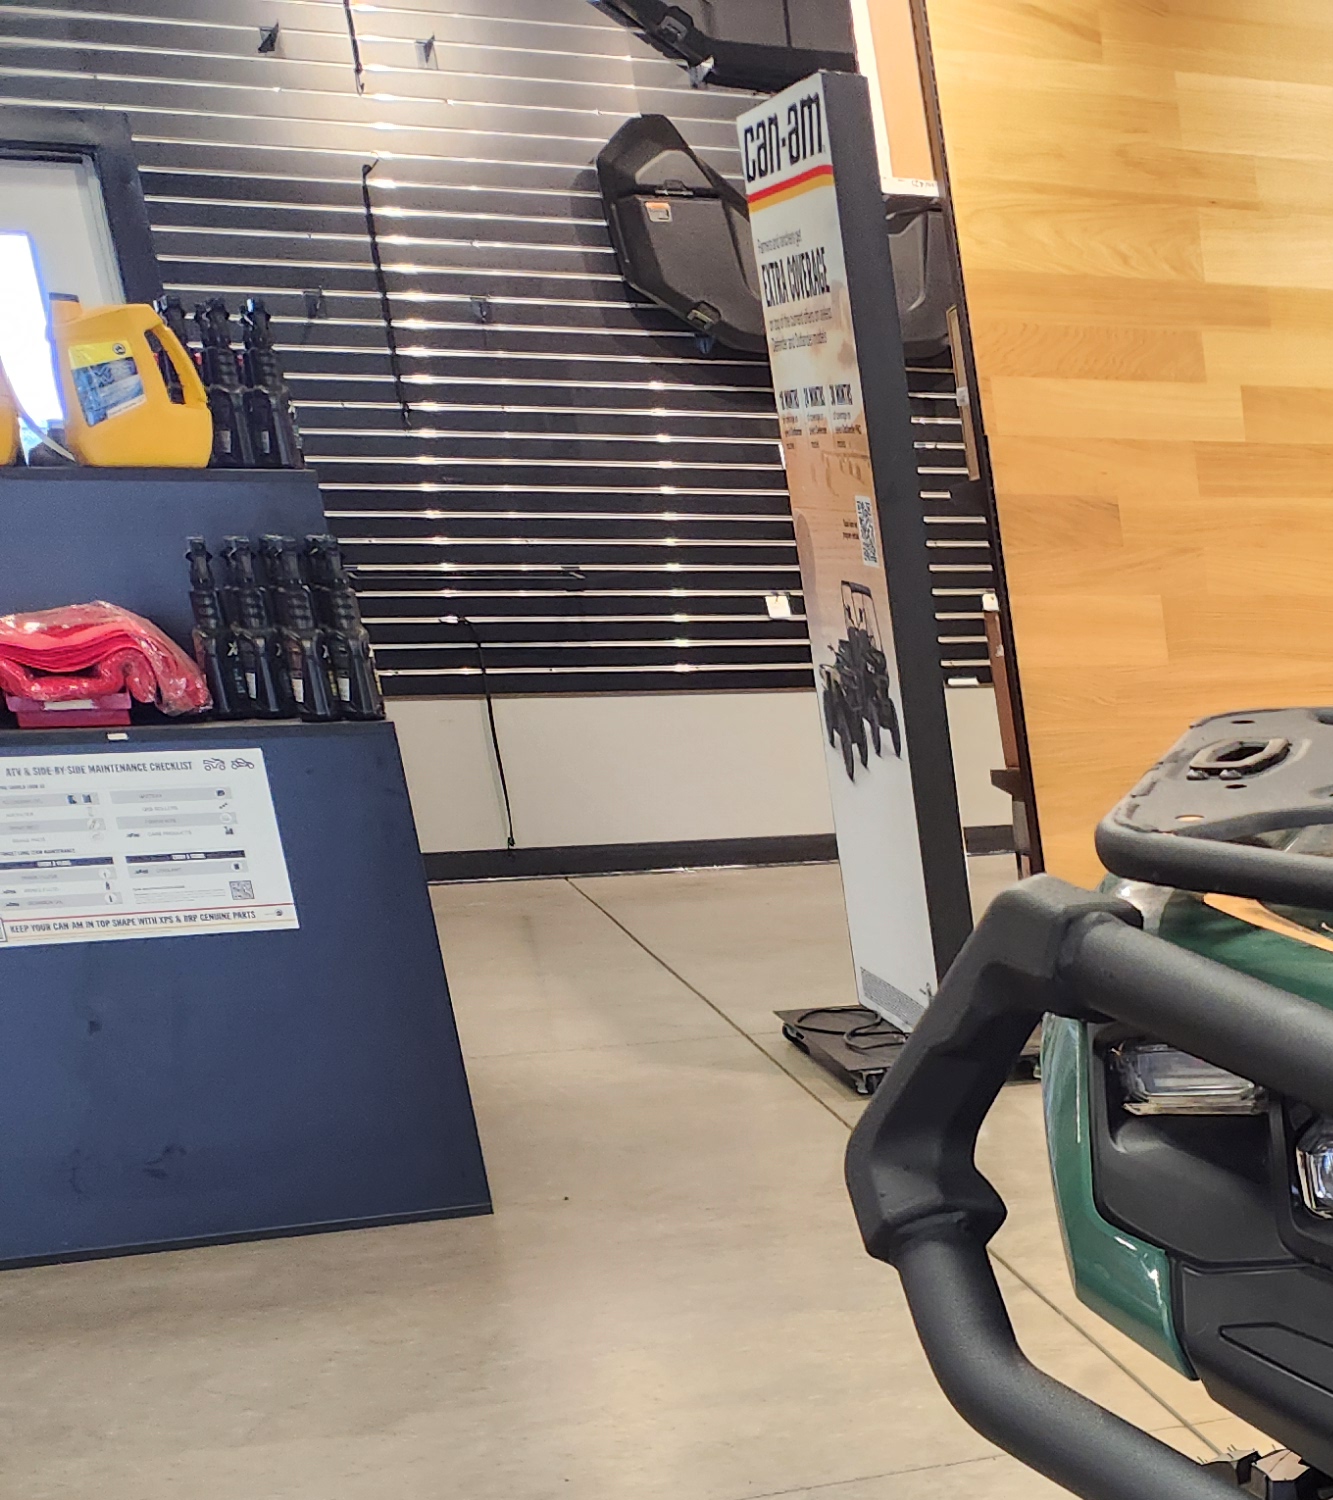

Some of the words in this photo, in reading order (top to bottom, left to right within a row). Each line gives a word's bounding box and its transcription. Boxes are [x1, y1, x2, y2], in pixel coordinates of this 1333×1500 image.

[744, 92, 822, 183] can-am
[761, 259, 790, 307] EXTRA
[787, 246, 830, 302] COVERAGE
[88, 763, 147, 774] MAINTENANCE
[150, 761, 192, 772] CHECKLIST
[10, 924, 29, 933] KEEP
[32, 923, 51, 932] YOUR
[96, 919, 110, 928] TOP
[112, 918, 136, 927] SHAPE
[233, 910, 256, 920] PARTS
